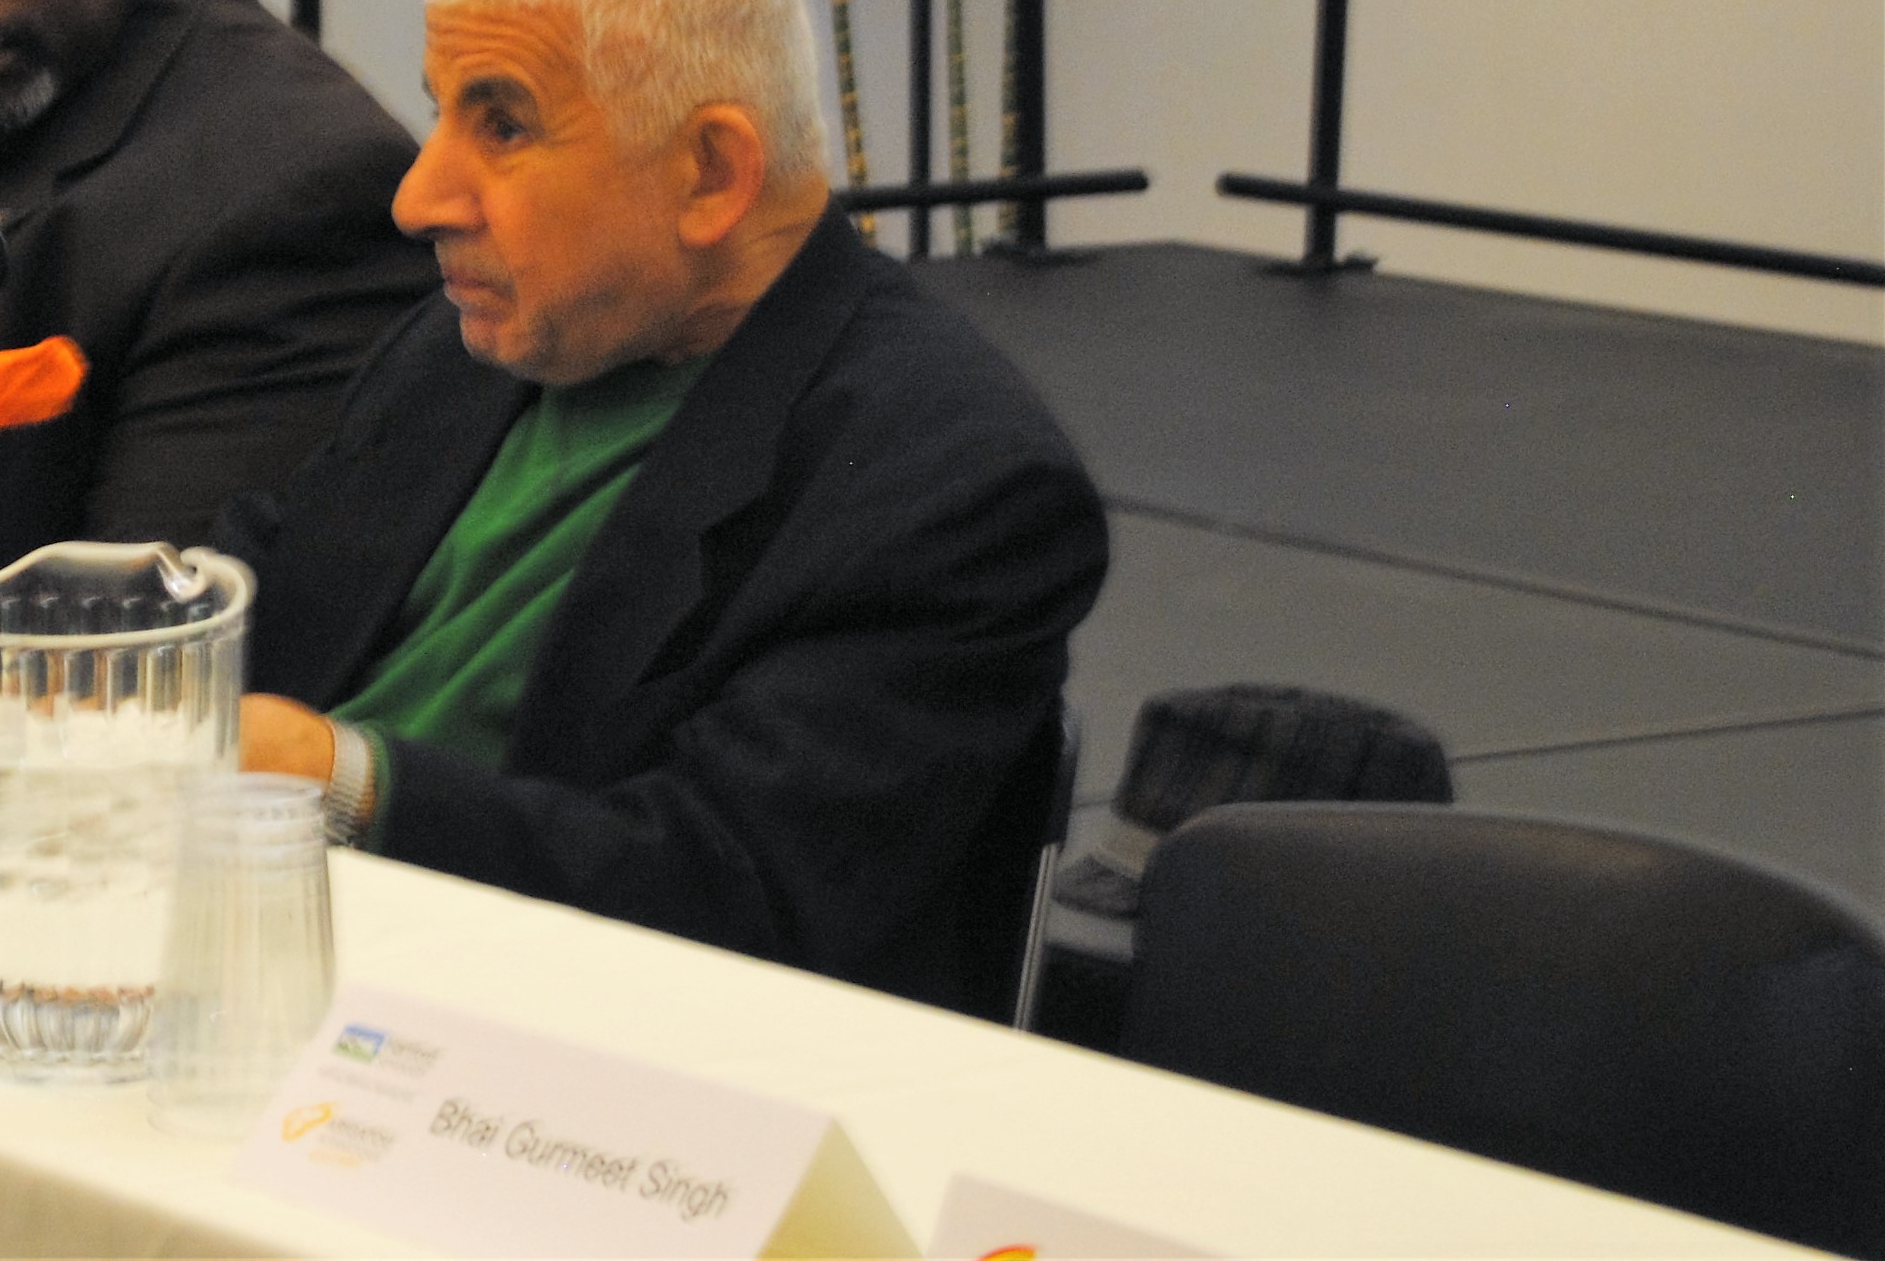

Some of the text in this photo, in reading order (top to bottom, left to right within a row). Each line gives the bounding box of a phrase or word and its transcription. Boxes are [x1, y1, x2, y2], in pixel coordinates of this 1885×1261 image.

[428, 1098, 504, 1147] Bhai
[504, 1118, 638, 1192] Gurmeet
[638, 1158, 730, 1222] Singh
